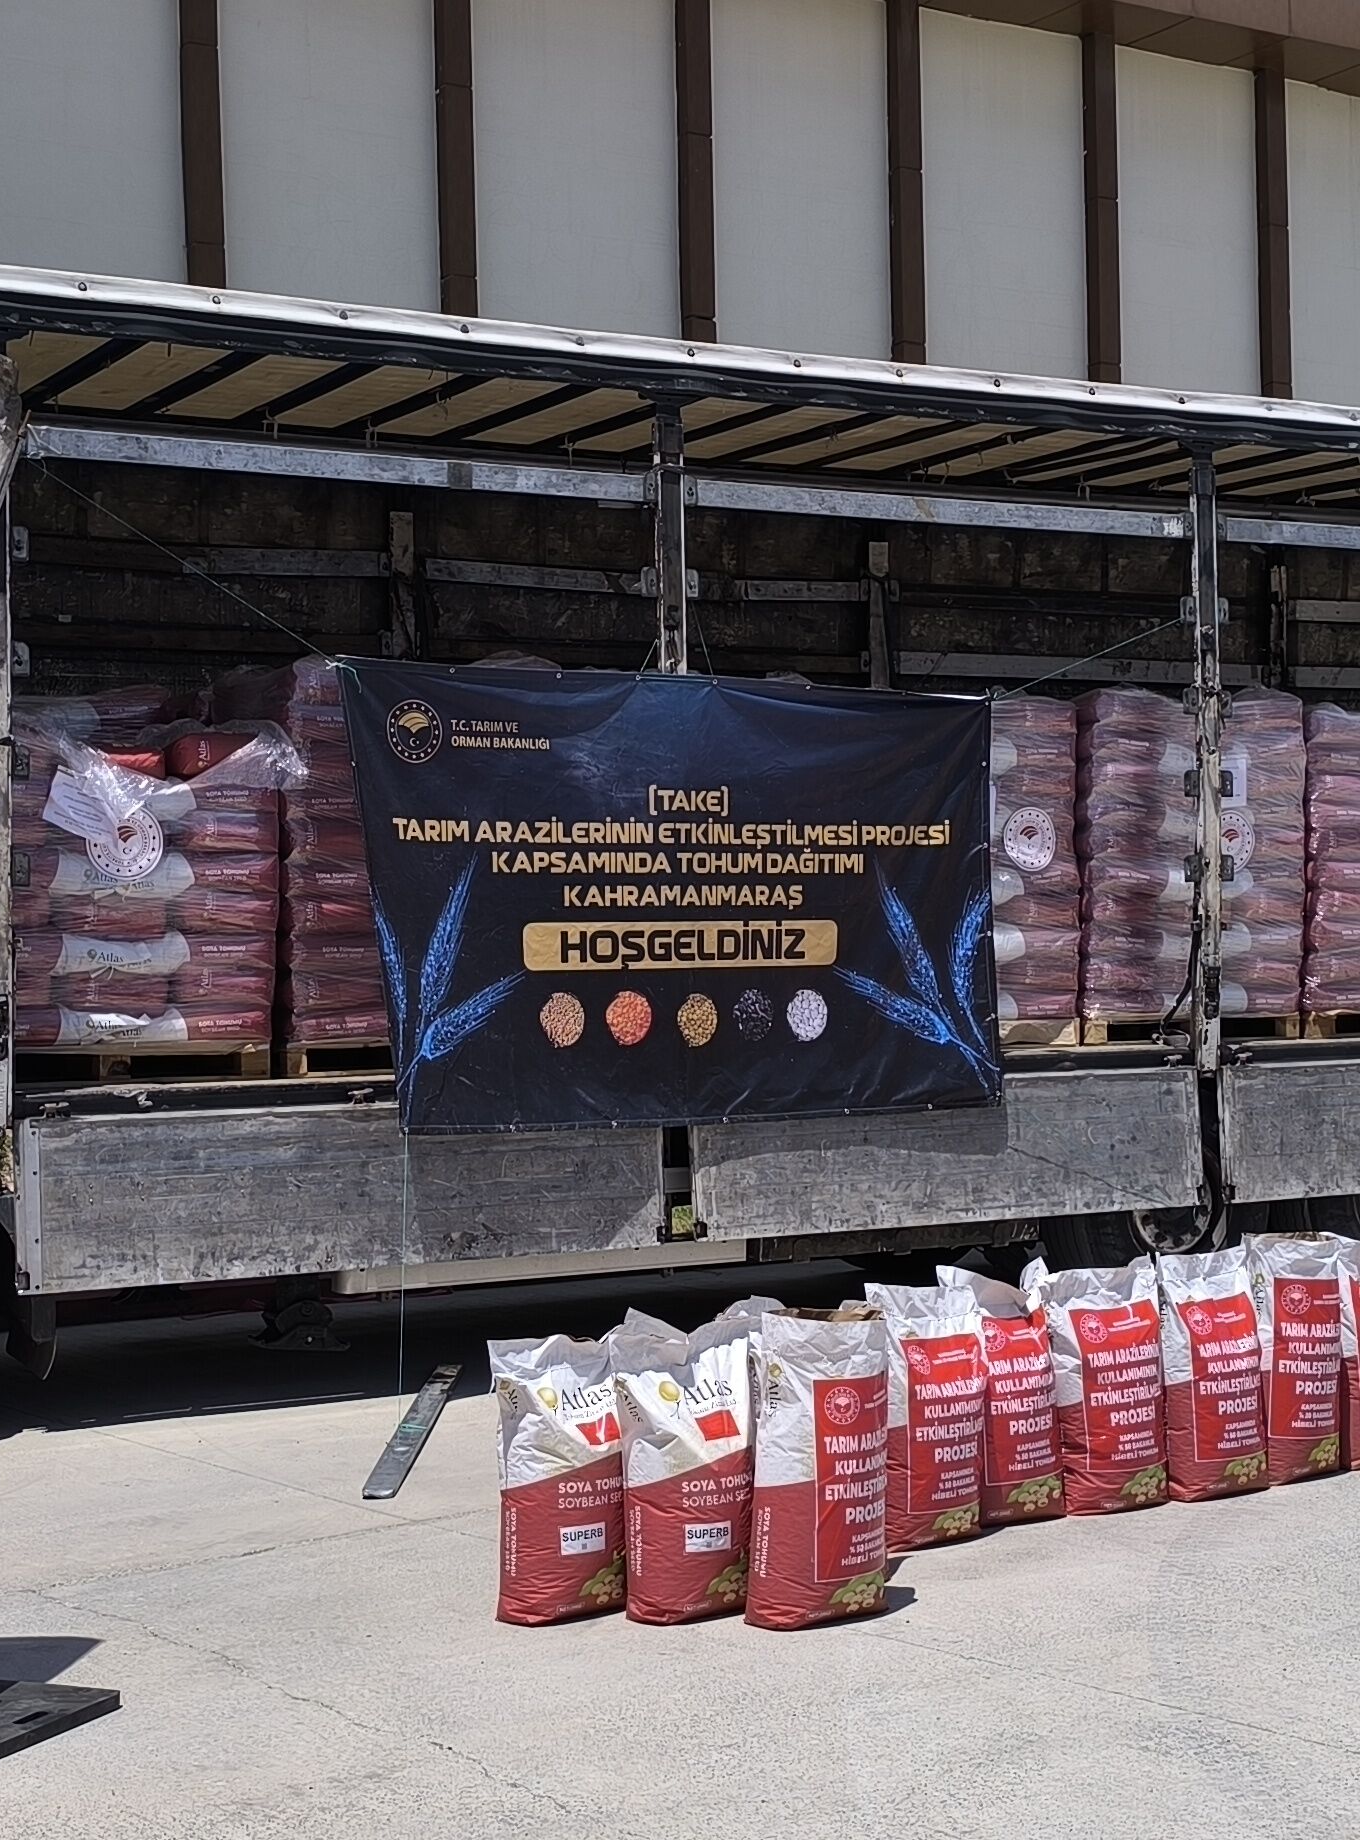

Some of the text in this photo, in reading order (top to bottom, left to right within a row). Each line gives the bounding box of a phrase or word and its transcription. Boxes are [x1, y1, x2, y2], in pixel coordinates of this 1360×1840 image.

[451, 720, 519, 733] T.C. TARIM VE
[451, 736, 550, 750] ORMAN BAKANLIĞI
[392, 816, 950, 849] TARIM ARAZİLERİNİN ETKİNLEŞTİLMESİ PROJESİ
[492, 848, 864, 874] KAPSAMINDA TOHUM DAĞITIMI
[563, 885, 804, 910] KAHRAMANMARAŞ
[560, 920, 806, 969] HOŞGELDİNİZ
[99, 952, 124, 963] Atlas
[1281, 1322, 1308, 1337] TARIM
[989, 1360, 1012, 1376] ARIM
[1088, 1352, 1114, 1368] TARIM
[683, 1379, 733, 1405] Atlas
[1296, 1376, 1337, 1395] PROJESİ
[561, 1384, 612, 1412] Atlas
[1219, 1390, 1258, 1416] PROJESİ
[1110, 1401, 1156, 1427] PROJESİ
[824, 1435, 858, 1454] TARIM
[558, 1481, 593, 1494] SOYA
[682, 1480, 717, 1493] SOYA
[558, 1494, 608, 1509] SOYBEAN
[683, 1493, 734, 1508] SOYBEAN
[562, 1527, 604, 1542] SUPERB
[687, 1527, 729, 1539] SUPERB
